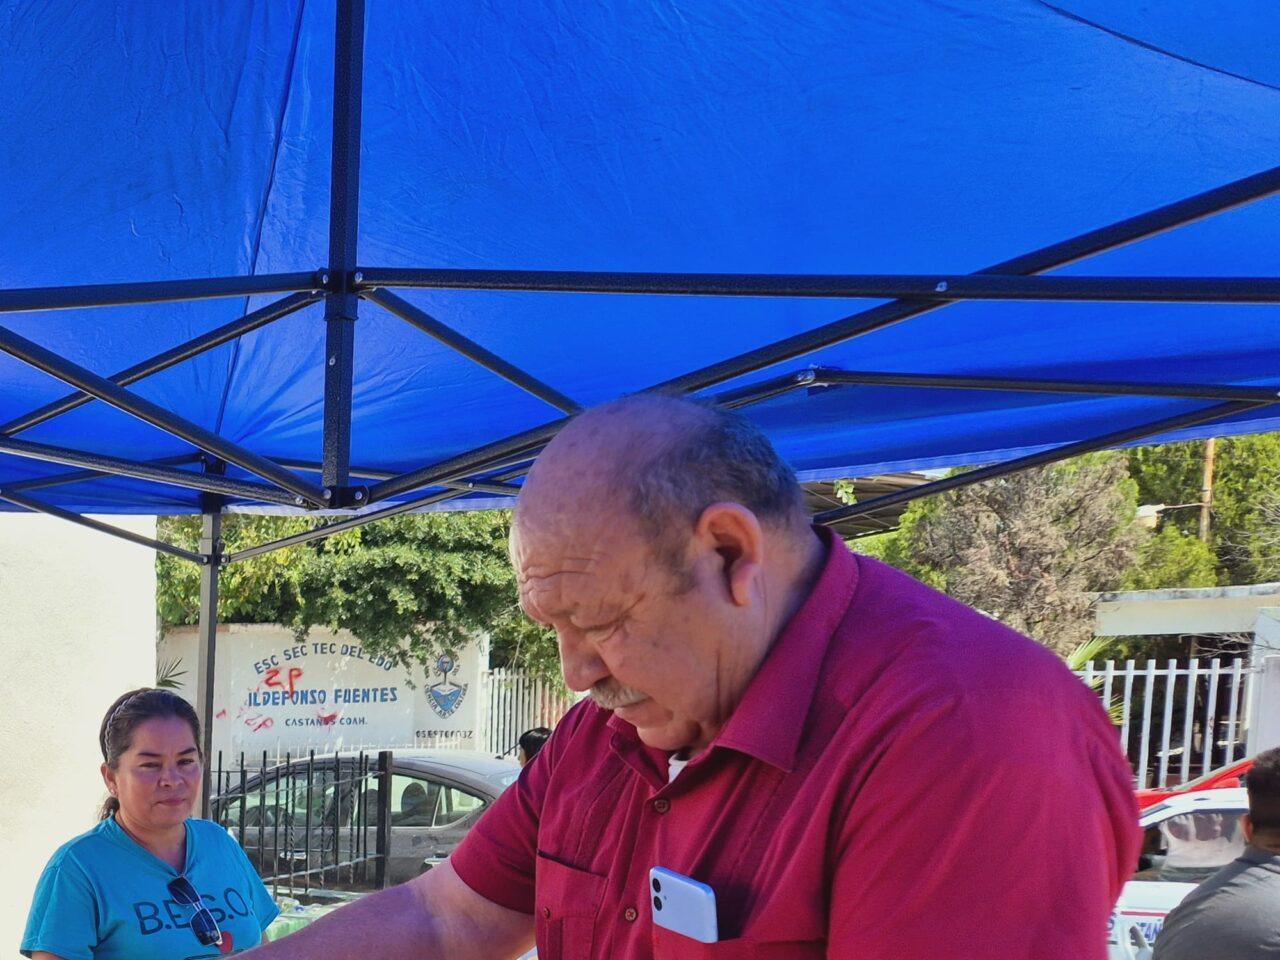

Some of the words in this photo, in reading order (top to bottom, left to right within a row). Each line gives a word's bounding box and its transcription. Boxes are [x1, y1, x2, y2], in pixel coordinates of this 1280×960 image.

[254, 654, 279, 675] ESC
[283, 645, 308, 661] SEC
[312, 642, 337, 654] TEC
[340, 644, 364, 660] DEL
[248, 689, 327, 707] ILDEFONSO
[334, 687, 398, 705] FUENTES
